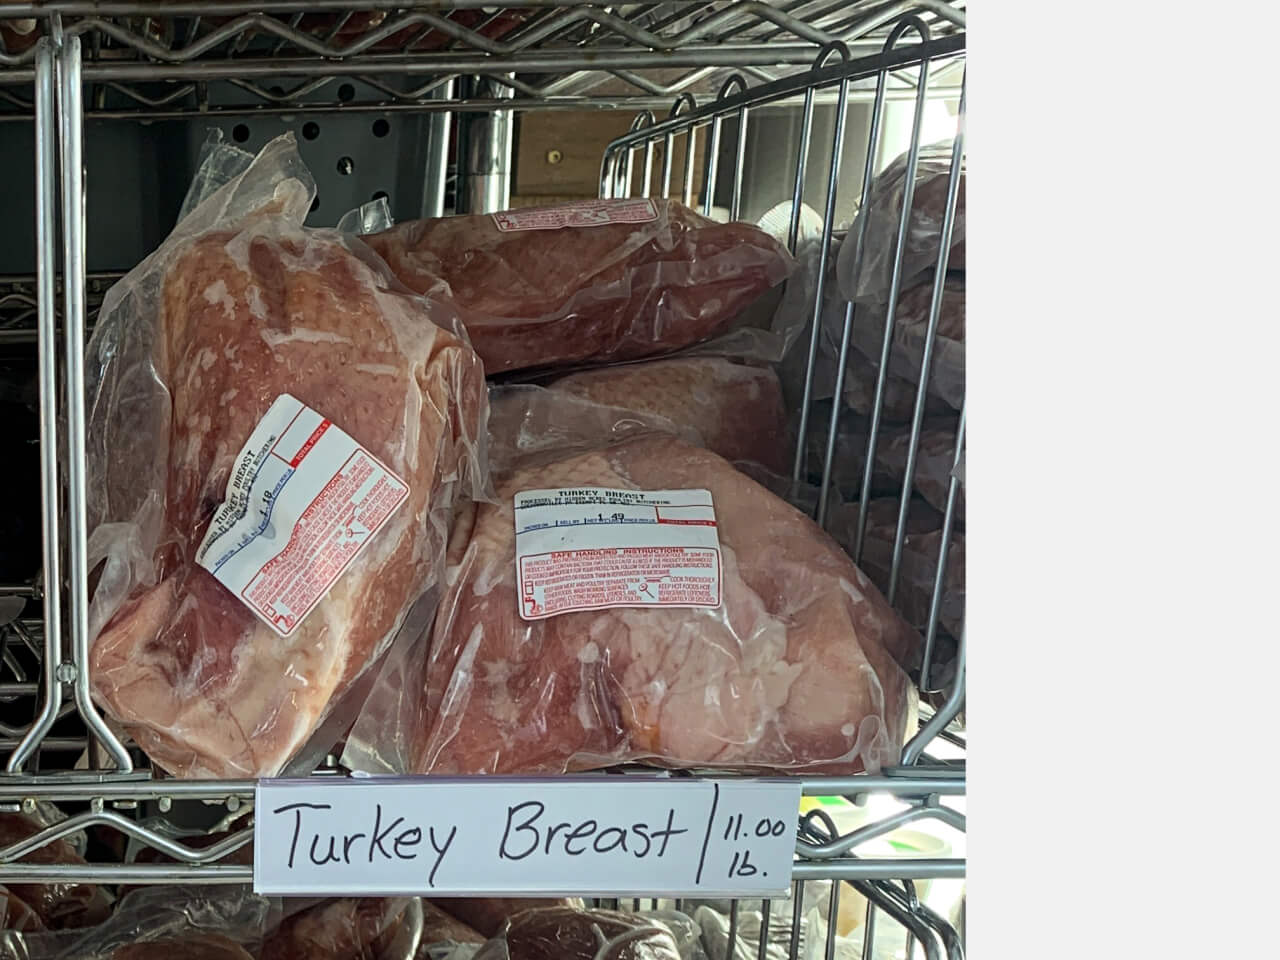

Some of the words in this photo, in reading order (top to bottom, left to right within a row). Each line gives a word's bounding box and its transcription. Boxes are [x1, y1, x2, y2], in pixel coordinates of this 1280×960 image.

[215, 492, 240, 525] TURKEY
[232, 450, 257, 489] BREAST
[303, 474, 344, 521] INSTRUCTIONS
[604, 490, 646, 500] BREAST
[551, 551, 572, 559] SAFE
[575, 549, 617, 557] HANDLING
[723, 814, 786, 841] 11.00
[274, 802, 458, 888] Turkey
[499, 801, 689, 861] Breast
[728, 850, 768, 879] lb.
